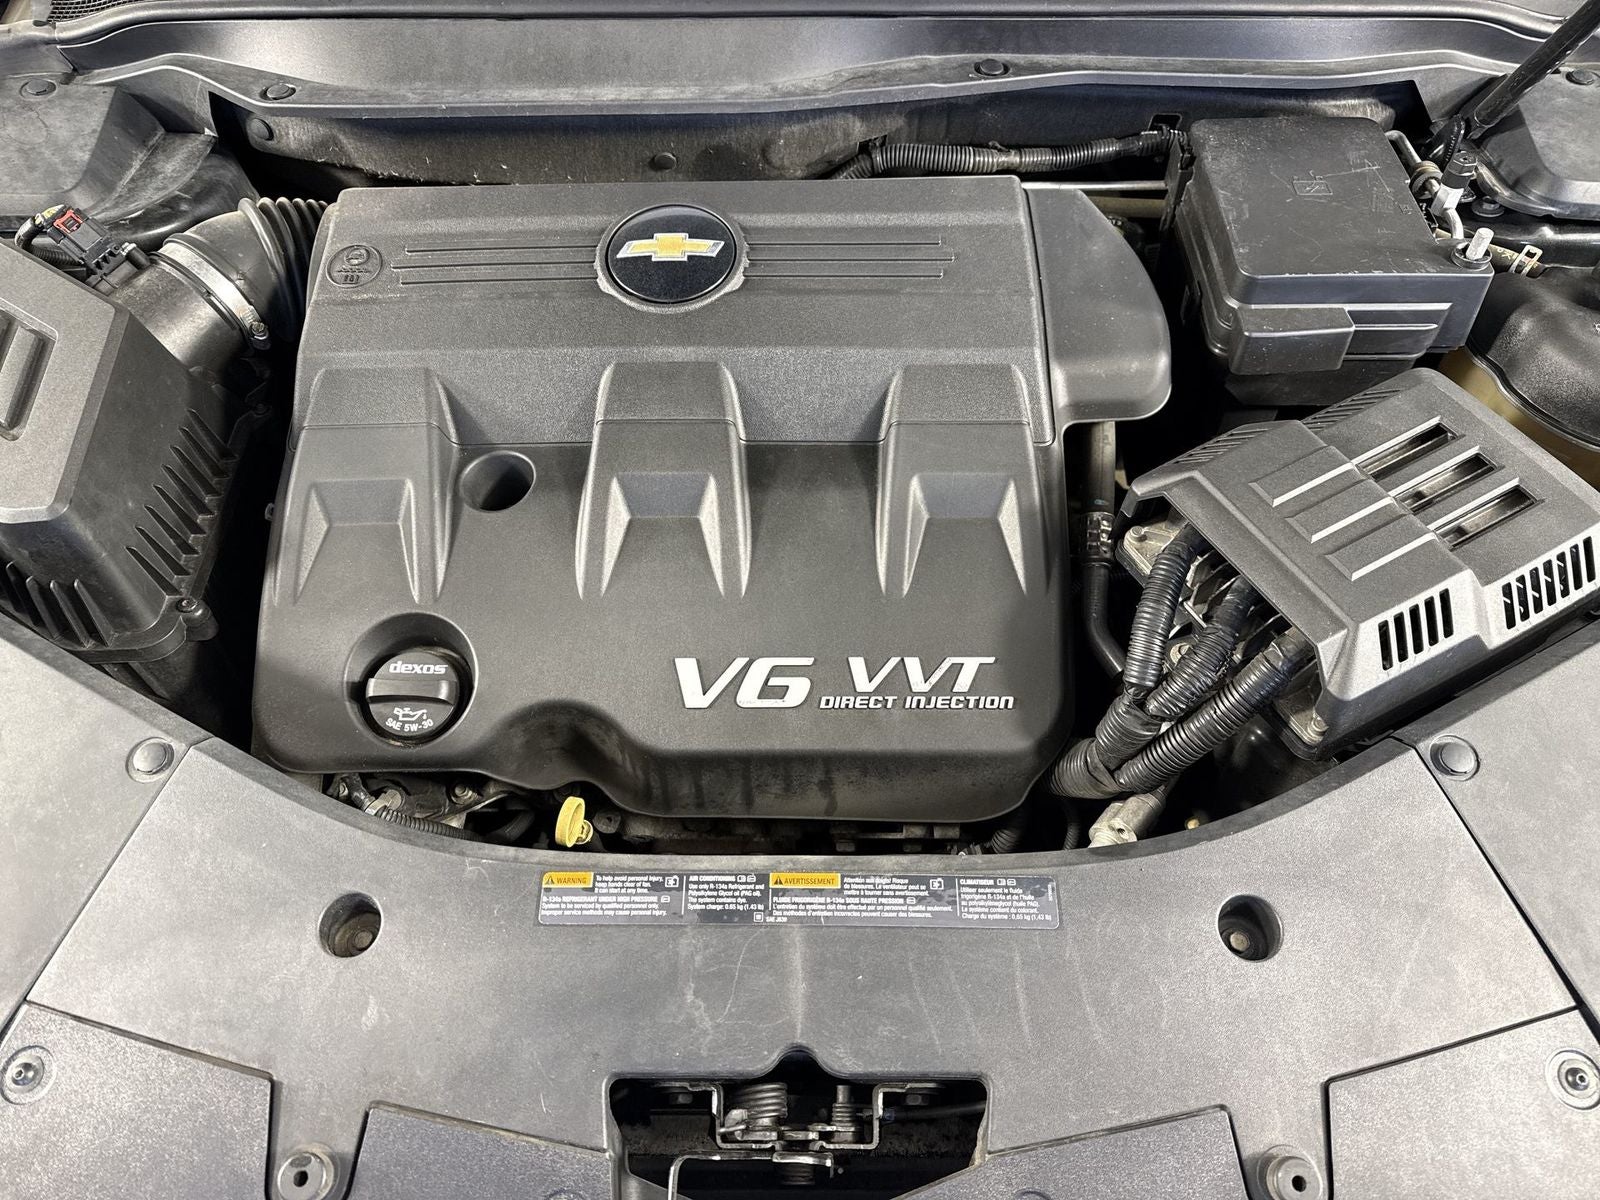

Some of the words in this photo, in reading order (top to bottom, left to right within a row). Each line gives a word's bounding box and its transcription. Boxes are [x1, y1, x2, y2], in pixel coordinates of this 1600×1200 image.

[389, 661, 448, 674] dexos
[674, 656, 815, 709] V6
[847, 656, 996, 692] VVT
[819, 695, 894, 709] DIRECT
[904, 695, 1014, 709] INJECTION
[385, 717, 402, 731] SAE
[404, 718, 434, 732] 5W-30
